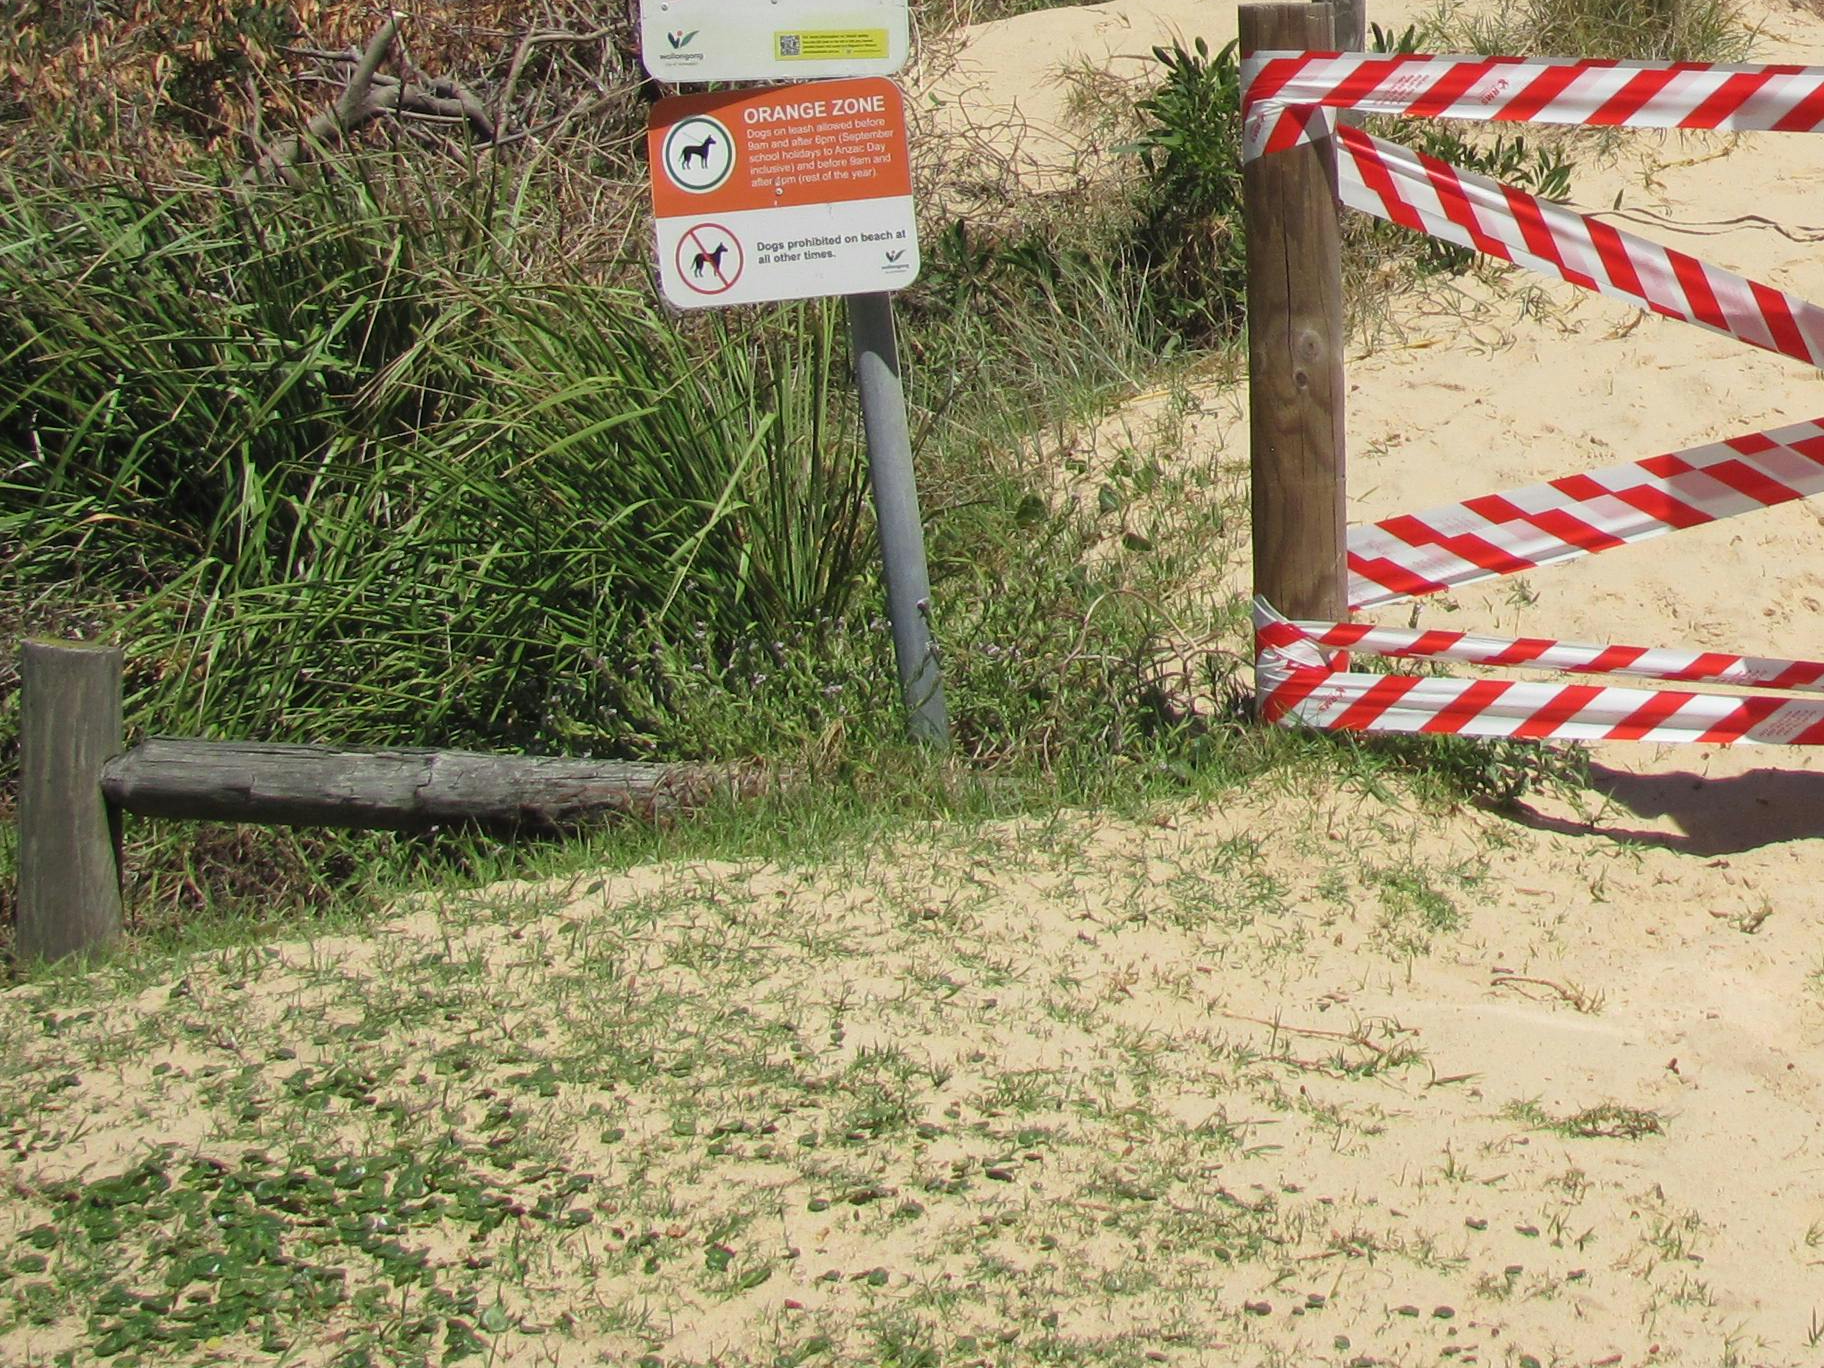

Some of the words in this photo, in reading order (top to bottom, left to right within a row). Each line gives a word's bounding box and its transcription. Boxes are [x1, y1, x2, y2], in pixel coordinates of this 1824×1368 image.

[744, 102, 827, 123] ORANGE
[832, 96, 885, 115] ZONE
[746, 129, 772, 139] Dogs
[773, 128, 786, 136] on
[788, 125, 815, 134] leash
[816, 121, 853, 132] allowed
[854, 118, 885, 128] before
[747, 141, 769, 151] 9am
[771, 139, 789, 149] and
[791, 137, 813, 146] after
[815, 135, 836, 145] 6pm
[838, 130, 893, 143] (September
[749, 153, 780, 163] school
[782, 149, 821, 159] holidays
[823, 148, 833, 156] to
[834, 145, 865, 154] Anzac
[866, 142, 885, 152] Day
[750, 163, 795, 174] inclusive)
[796, 160, 815, 171] and
[817, 158, 848, 169] before
[849, 156, 871, 166] 9am
[873, 153, 891, 163] and
[751, 177, 773, 187] after
[798, 173, 820, 184] (rest
[822, 171, 832, 181] of
[833, 171, 849, 179] the
[757, 242, 785, 252] Dogs
[787, 235, 842, 250] prohibited
[844, 235, 858, 244] on
[860, 231, 893, 242] beach
[896, 230, 906, 239] at
[758, 254, 771, 264] all
[773, 253, 801, 263] other
